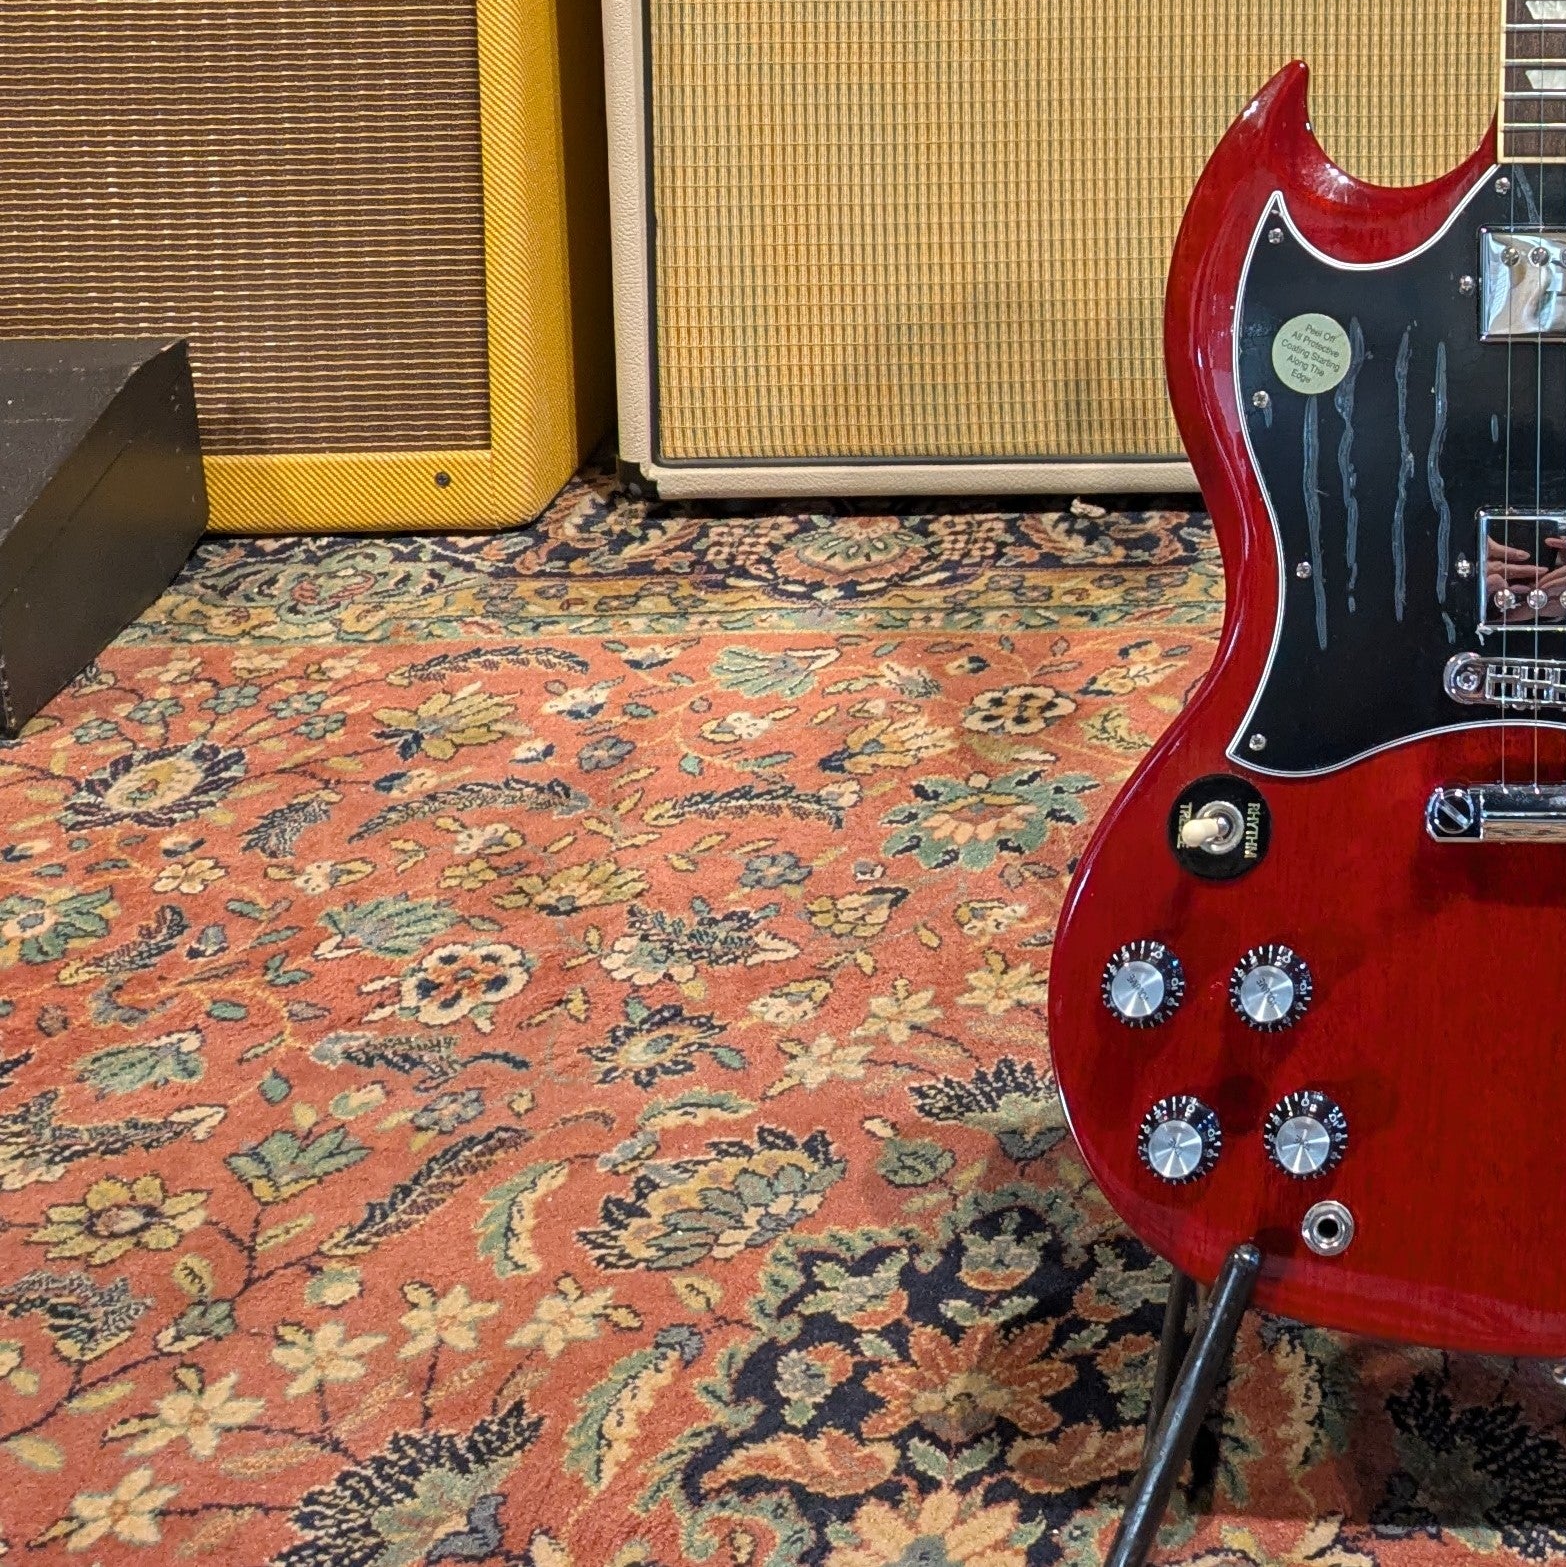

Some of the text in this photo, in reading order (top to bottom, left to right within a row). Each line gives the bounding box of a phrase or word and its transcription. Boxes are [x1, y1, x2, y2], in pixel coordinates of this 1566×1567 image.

[1303, 336, 1340, 358] Protective
[1323, 332, 1336, 343] Off
[1281, 339, 1340, 373] Coating Starting
[1287, 354, 1325, 377] Along The
[1291, 369, 1311, 384] Edge
[1244, 803, 1260, 859] RHYTHM
